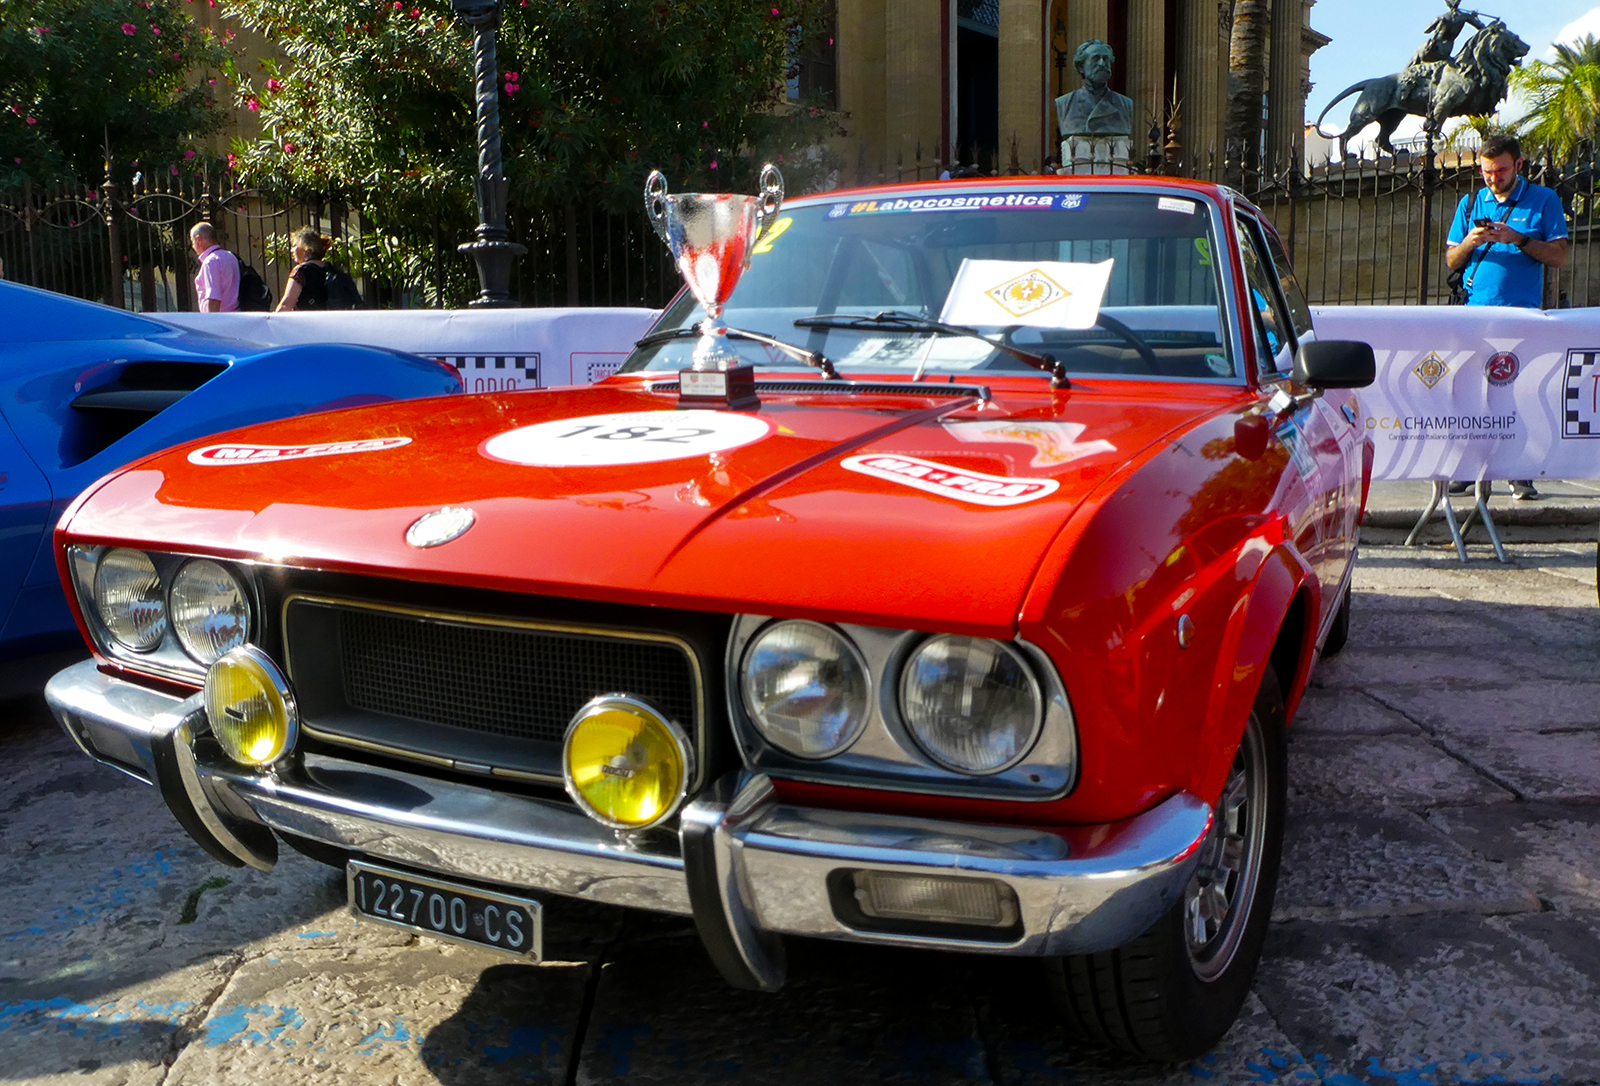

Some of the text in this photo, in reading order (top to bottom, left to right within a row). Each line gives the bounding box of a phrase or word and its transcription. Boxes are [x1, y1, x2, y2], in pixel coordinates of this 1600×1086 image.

[851, 194, 1053, 213] #Labocosmetica
[752, 217, 793, 254] 2
[556, 425, 716, 443] 182
[1388, 433, 1425, 441] Campionato
[1499, 433, 1516, 441] Sport
[358, 875, 524, 947] 122700 CS
